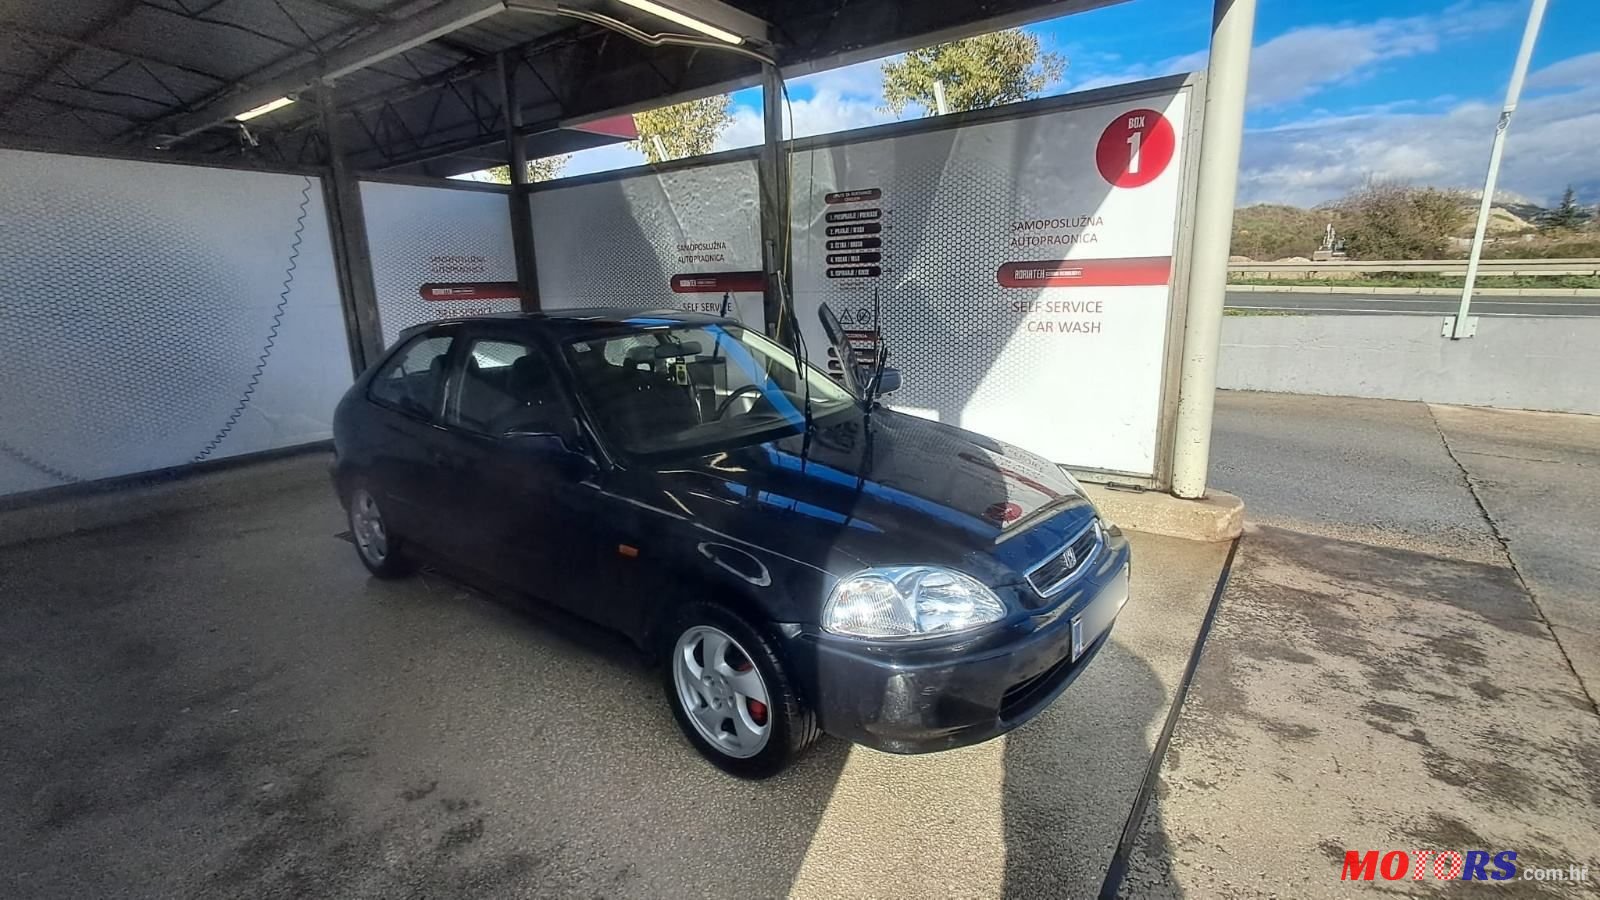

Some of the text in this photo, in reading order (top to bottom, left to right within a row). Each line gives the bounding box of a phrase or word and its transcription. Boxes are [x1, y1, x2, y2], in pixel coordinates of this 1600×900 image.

[1128, 116, 1145, 129] BOX
[1126, 131, 1142, 174] 1
[1011, 215, 1104, 231] SAMOPOSLUŽNA
[1010, 233, 1098, 247] AUTOPRAONICA
[683, 303, 732, 312] SELF SERVE
[1012, 301, 1103, 313] SELF SERVICE
[1027, 321, 1101, 333] CAR WASH
